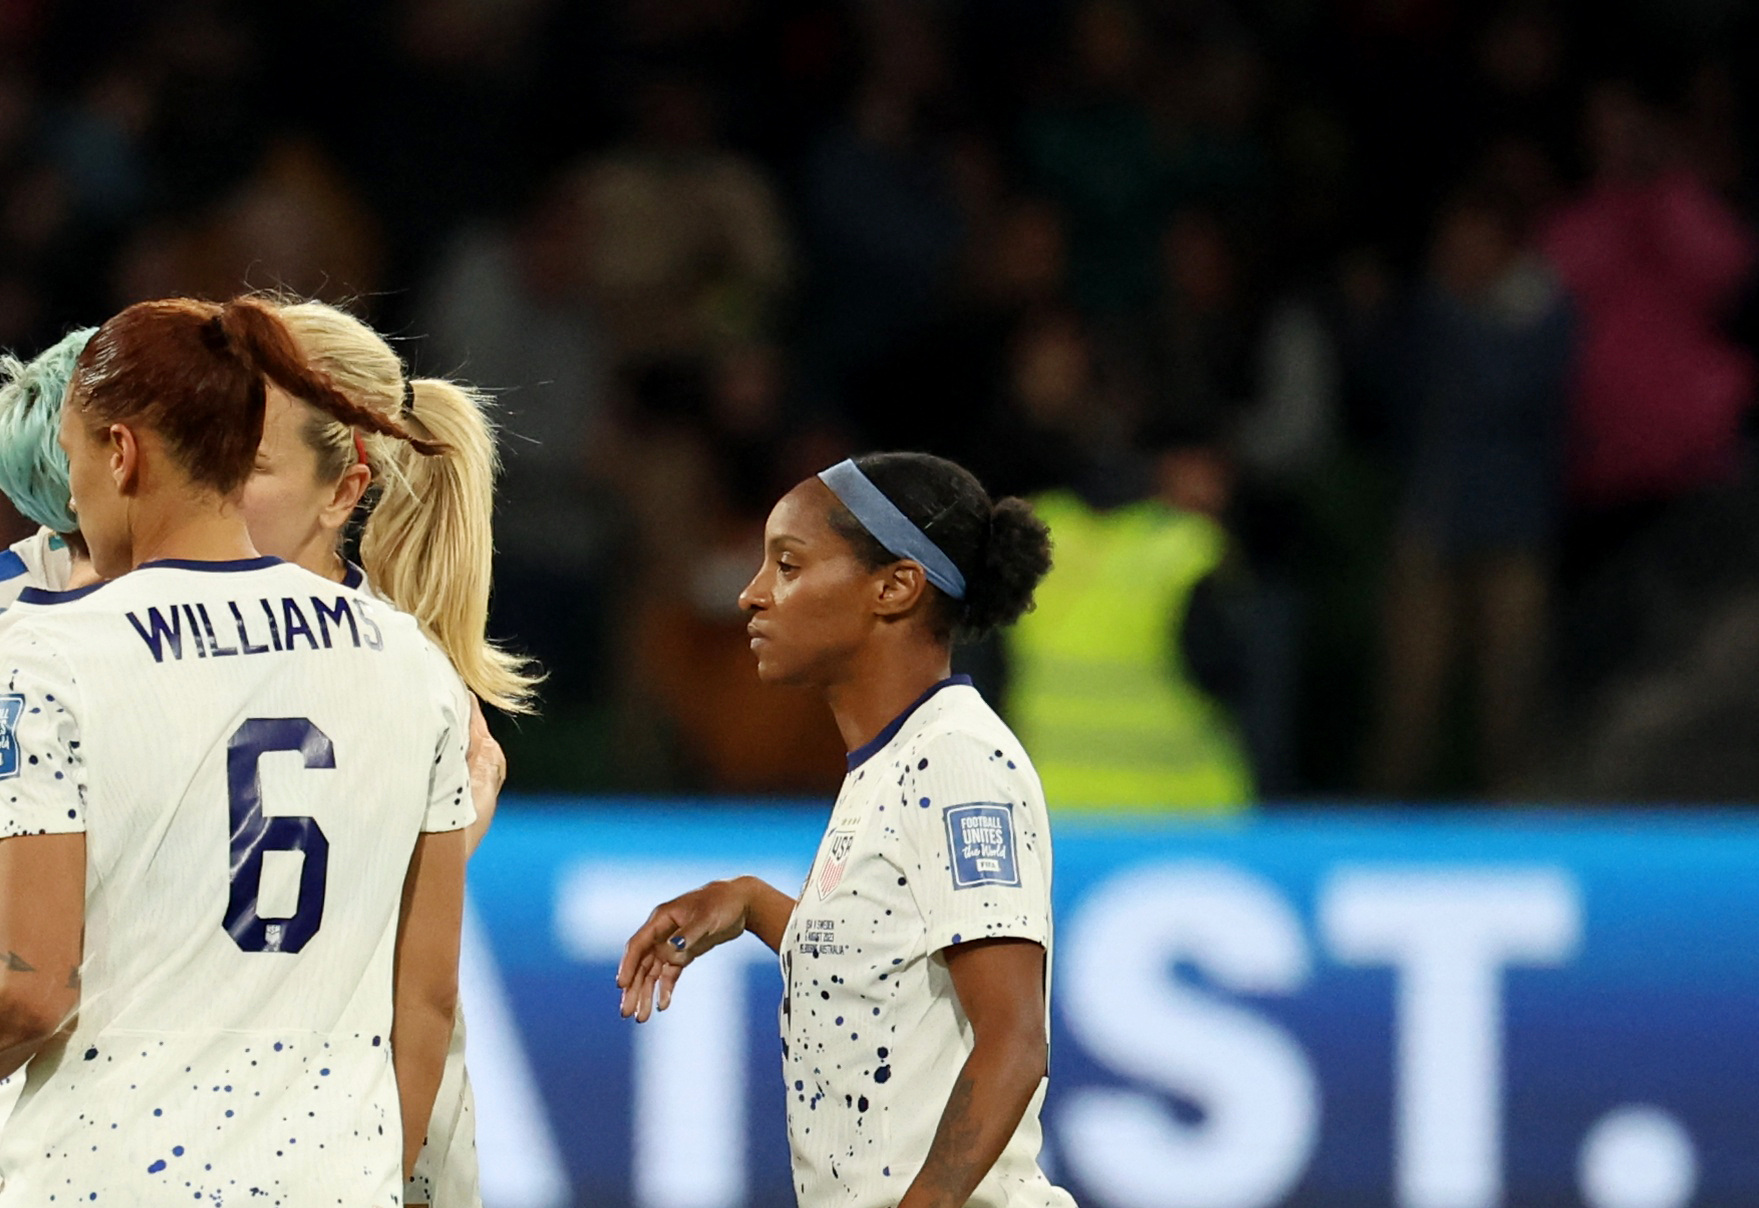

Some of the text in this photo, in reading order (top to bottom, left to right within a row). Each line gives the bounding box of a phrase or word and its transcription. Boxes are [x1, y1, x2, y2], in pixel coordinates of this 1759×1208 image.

[125, 596, 384, 663] WILLIAMS
[961, 815, 1003, 829] FOOTBALL
[222, 717, 337, 954] 6
[962, 828, 1003, 845] UNITES
[831, 835, 854, 861] USA
[980, 843, 1007, 860] World
